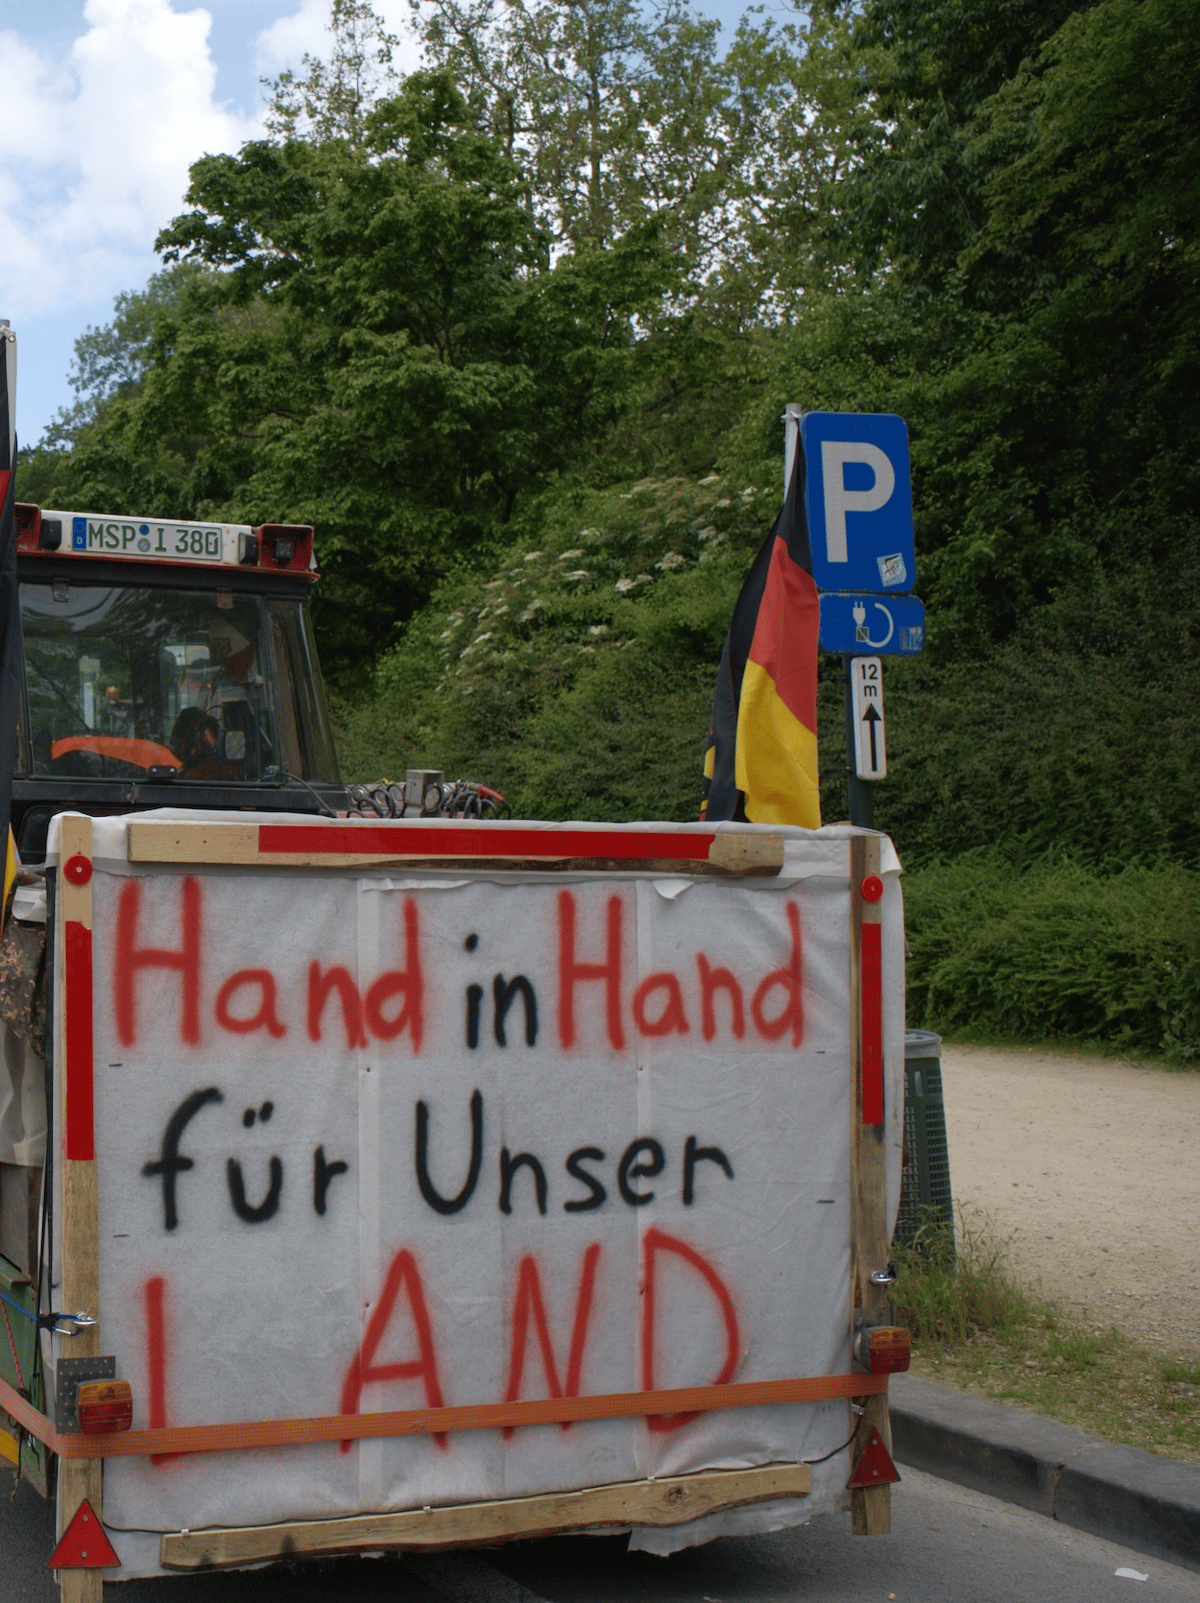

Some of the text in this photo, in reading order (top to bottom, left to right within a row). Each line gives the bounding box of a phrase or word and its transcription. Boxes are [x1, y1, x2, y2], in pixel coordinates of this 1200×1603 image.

[88, 522, 136, 549] MSP
[155, 527, 167, 552] I
[175, 528, 219, 555] 380
[820, 440, 896, 563] P
[861, 664, 878, 680] 12
[864, 685, 877, 697] m
[114, 876, 806, 1052] Hand in Hand
[143, 1086, 734, 1231] für Unser
[143, 1226, 741, 1466] LAND
